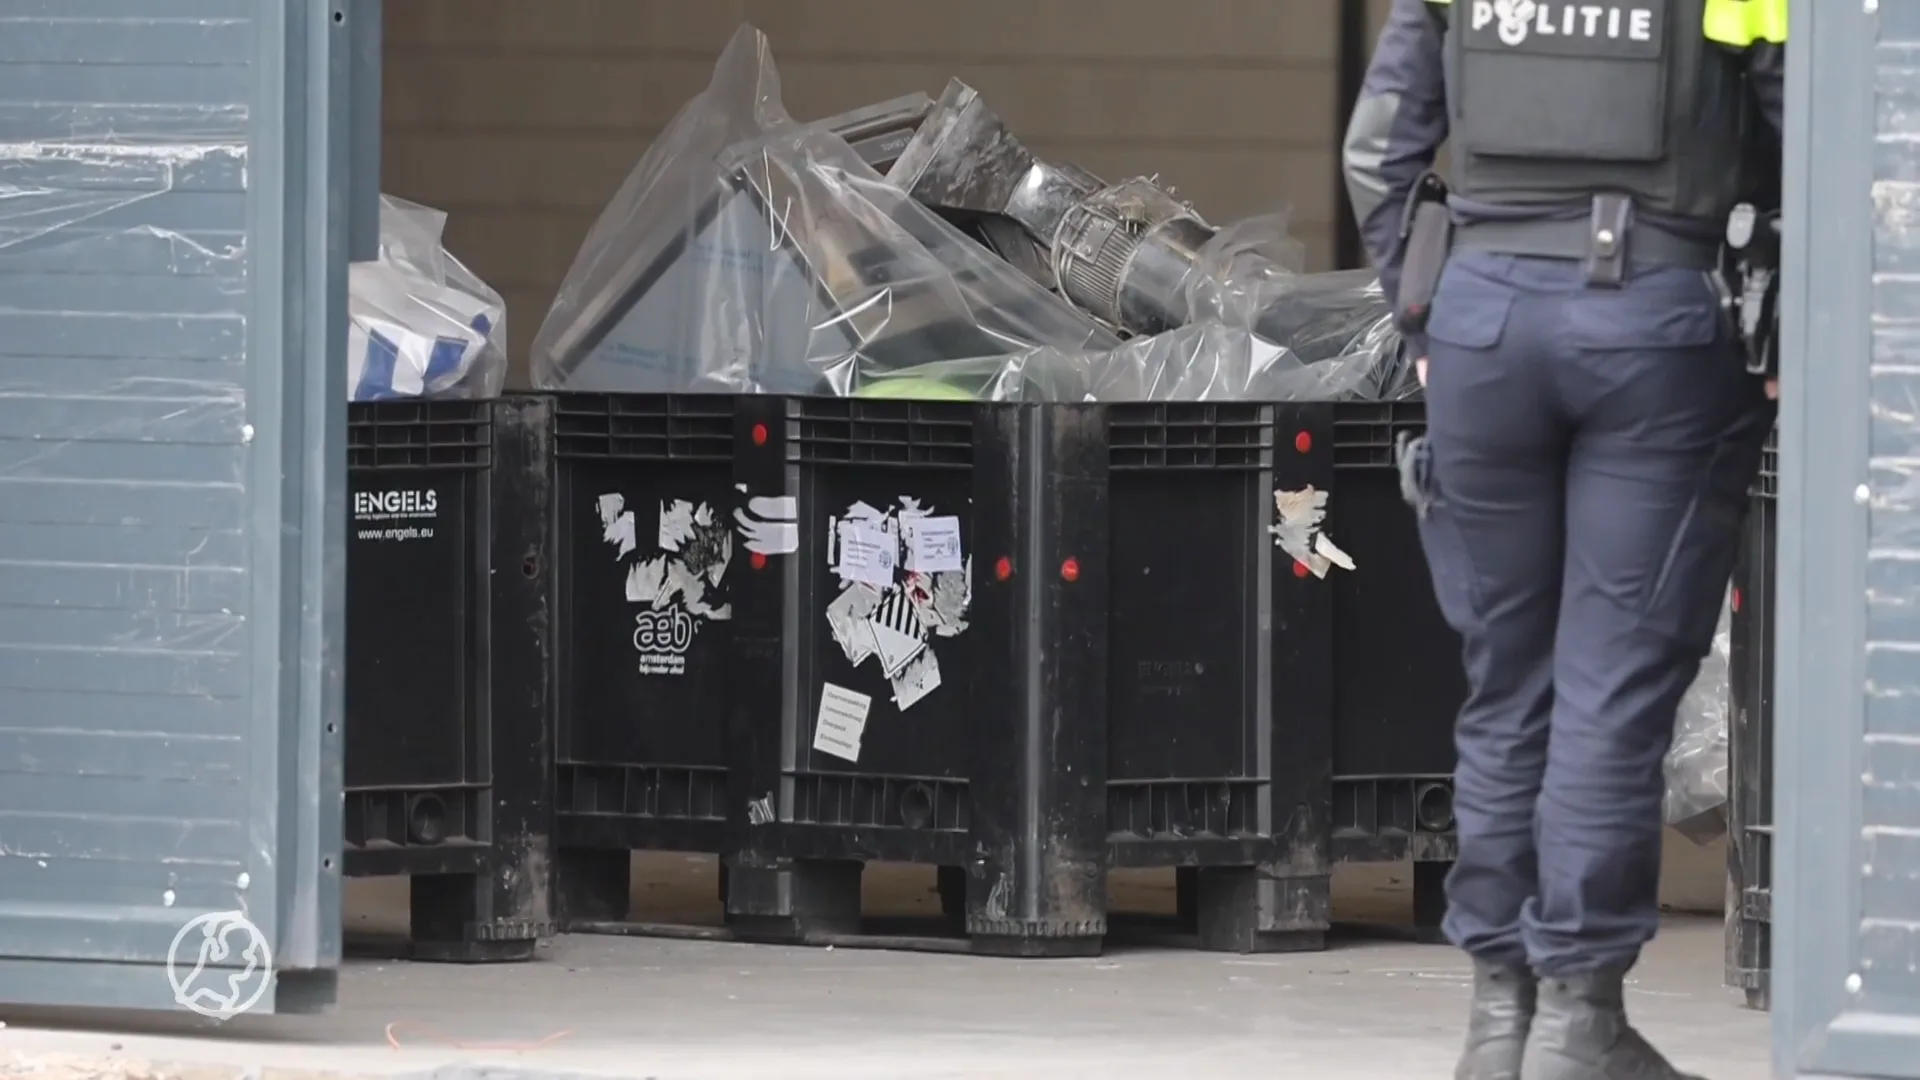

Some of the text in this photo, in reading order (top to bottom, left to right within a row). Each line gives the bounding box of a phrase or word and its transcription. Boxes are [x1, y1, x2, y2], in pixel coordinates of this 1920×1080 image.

[355, 489, 437, 513] ENGELS
[358, 526, 434, 541] www.engels.eu
[640, 653, 685, 664] amsterdam
